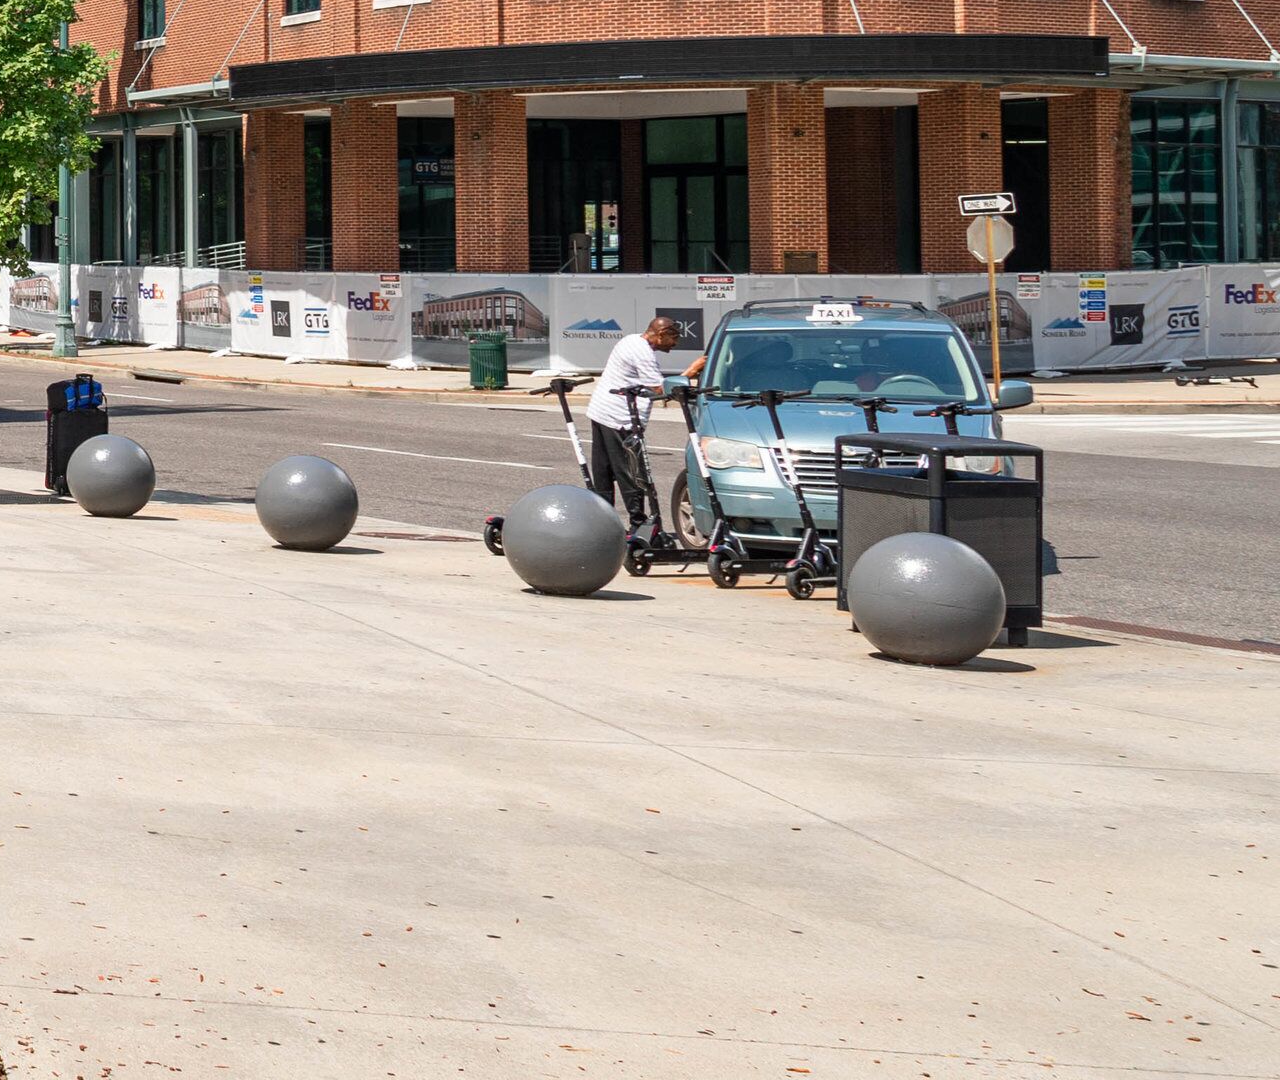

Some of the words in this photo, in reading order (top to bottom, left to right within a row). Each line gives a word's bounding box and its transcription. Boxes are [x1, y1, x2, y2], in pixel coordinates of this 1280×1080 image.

[415, 162, 438, 172] GTG
[967, 201, 981, 209] ONE
[983, 200, 997, 208] WAY
[138, 282, 165, 300] FedEx
[1225, 283, 1277, 304] FedEx
[111, 301, 128, 314] GTG
[348, 291, 391, 311] FedEx
[273, 311, 289, 327] LRK
[304, 313, 329, 329] GTG
[818, 309, 850, 318] TAXI
[1167, 311, 1200, 329] GTG
[1114, 317, 1139, 334] LRK
